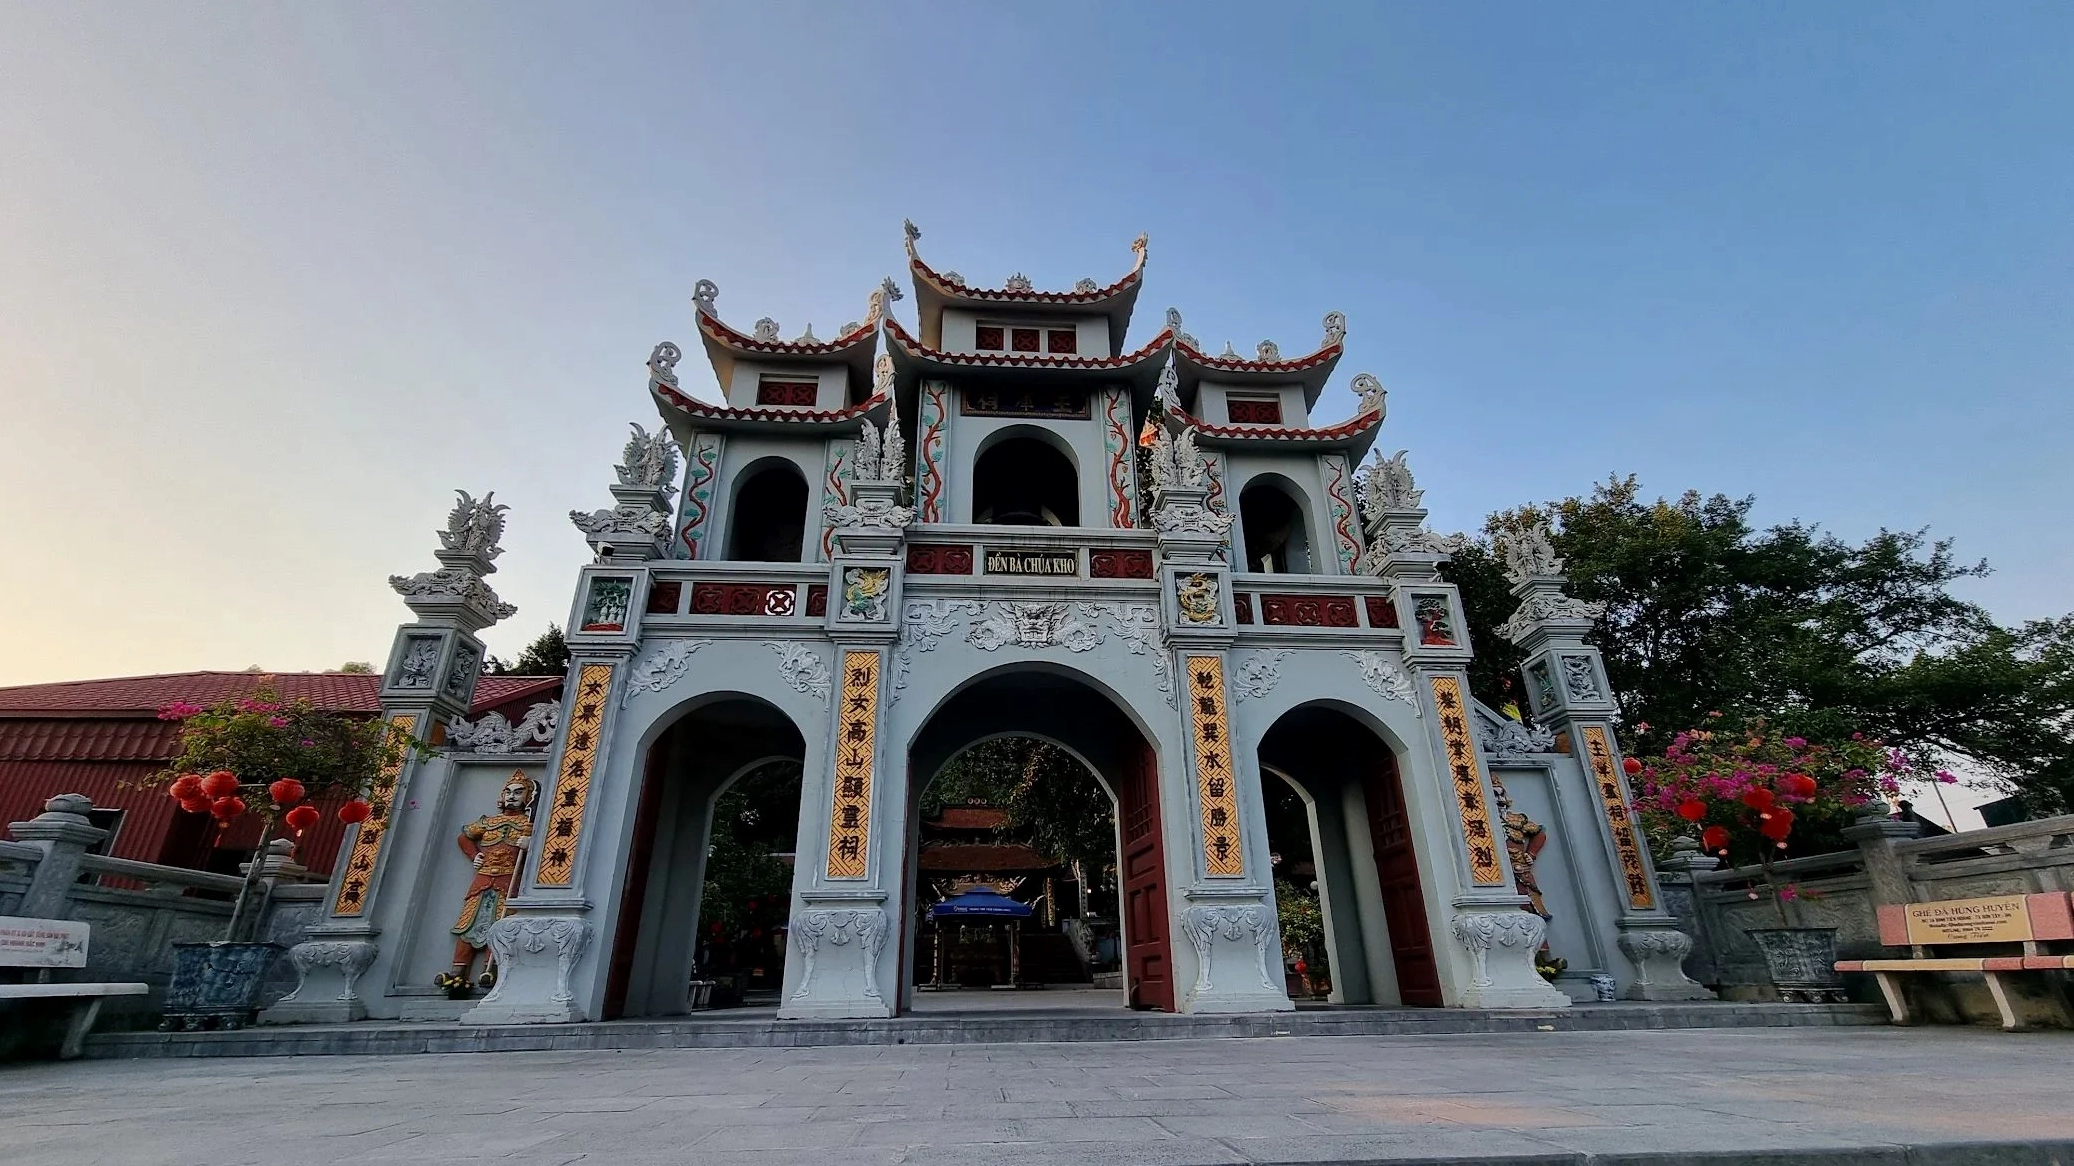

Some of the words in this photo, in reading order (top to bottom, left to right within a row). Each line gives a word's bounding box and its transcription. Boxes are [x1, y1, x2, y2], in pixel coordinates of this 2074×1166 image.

[988, 552, 1008, 572] ĐỀN
[1010, 553, 1023, 573] BÀ
[1024, 554, 1052, 574] CHÚA
[1053, 558, 1075, 574] KHO
